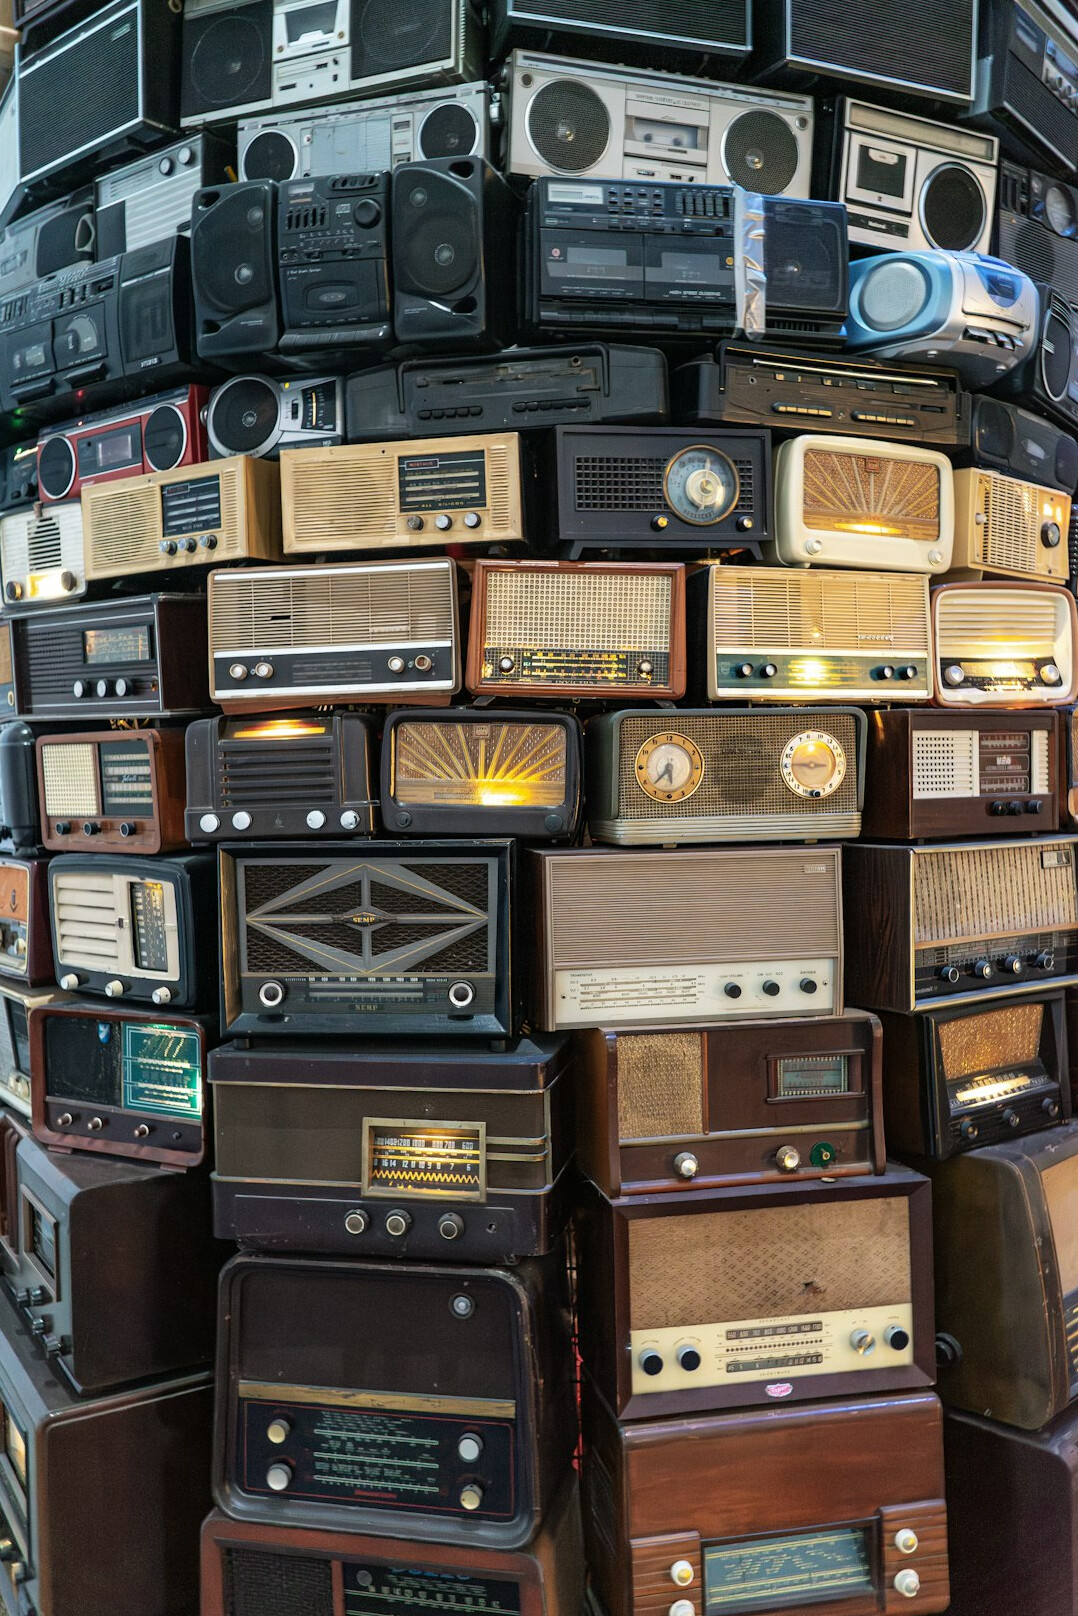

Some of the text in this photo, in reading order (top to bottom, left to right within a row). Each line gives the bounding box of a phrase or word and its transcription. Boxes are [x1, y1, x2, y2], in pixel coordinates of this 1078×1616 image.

[398, 1138, 411, 1147] 1200
[412, 1139, 426, 1148] 1000
[444, 1141, 456, 1150] 700
[462, 1141, 474, 1150] 600
[382, 1159, 388, 1167] 16
[402, 1160, 409, 1168] 12
[410, 1161, 416, 1169] 11
[418, 1161, 425, 1169] 10
[427, 1161, 432, 1169] 9
[466, 1164, 471, 1172] 6
